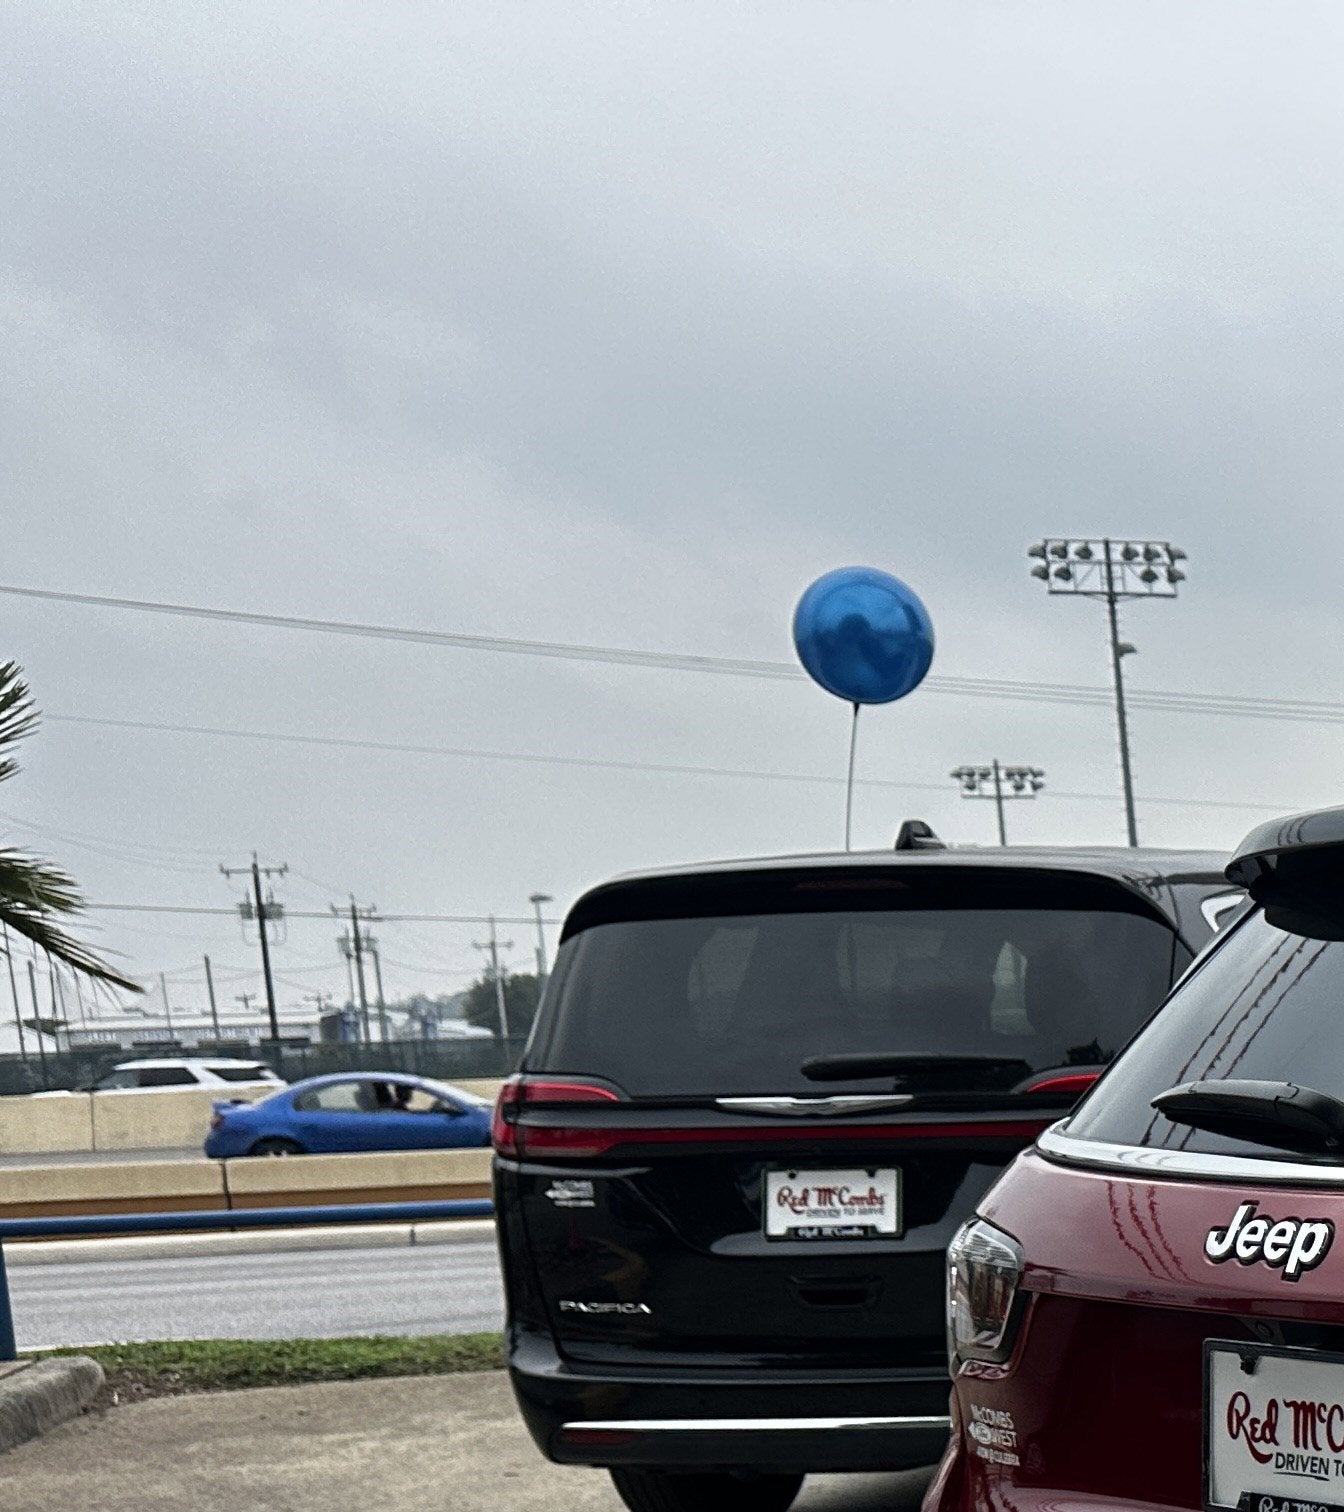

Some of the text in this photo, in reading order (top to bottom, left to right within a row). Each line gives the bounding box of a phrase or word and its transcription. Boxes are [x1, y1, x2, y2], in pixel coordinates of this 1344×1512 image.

[777, 1186, 809, 1215] Red
[1204, 1201, 1334, 1281] Jeep
[1227, 1391, 1280, 1464] Red
[1275, 1452, 1330, 1476] DRIVEN
